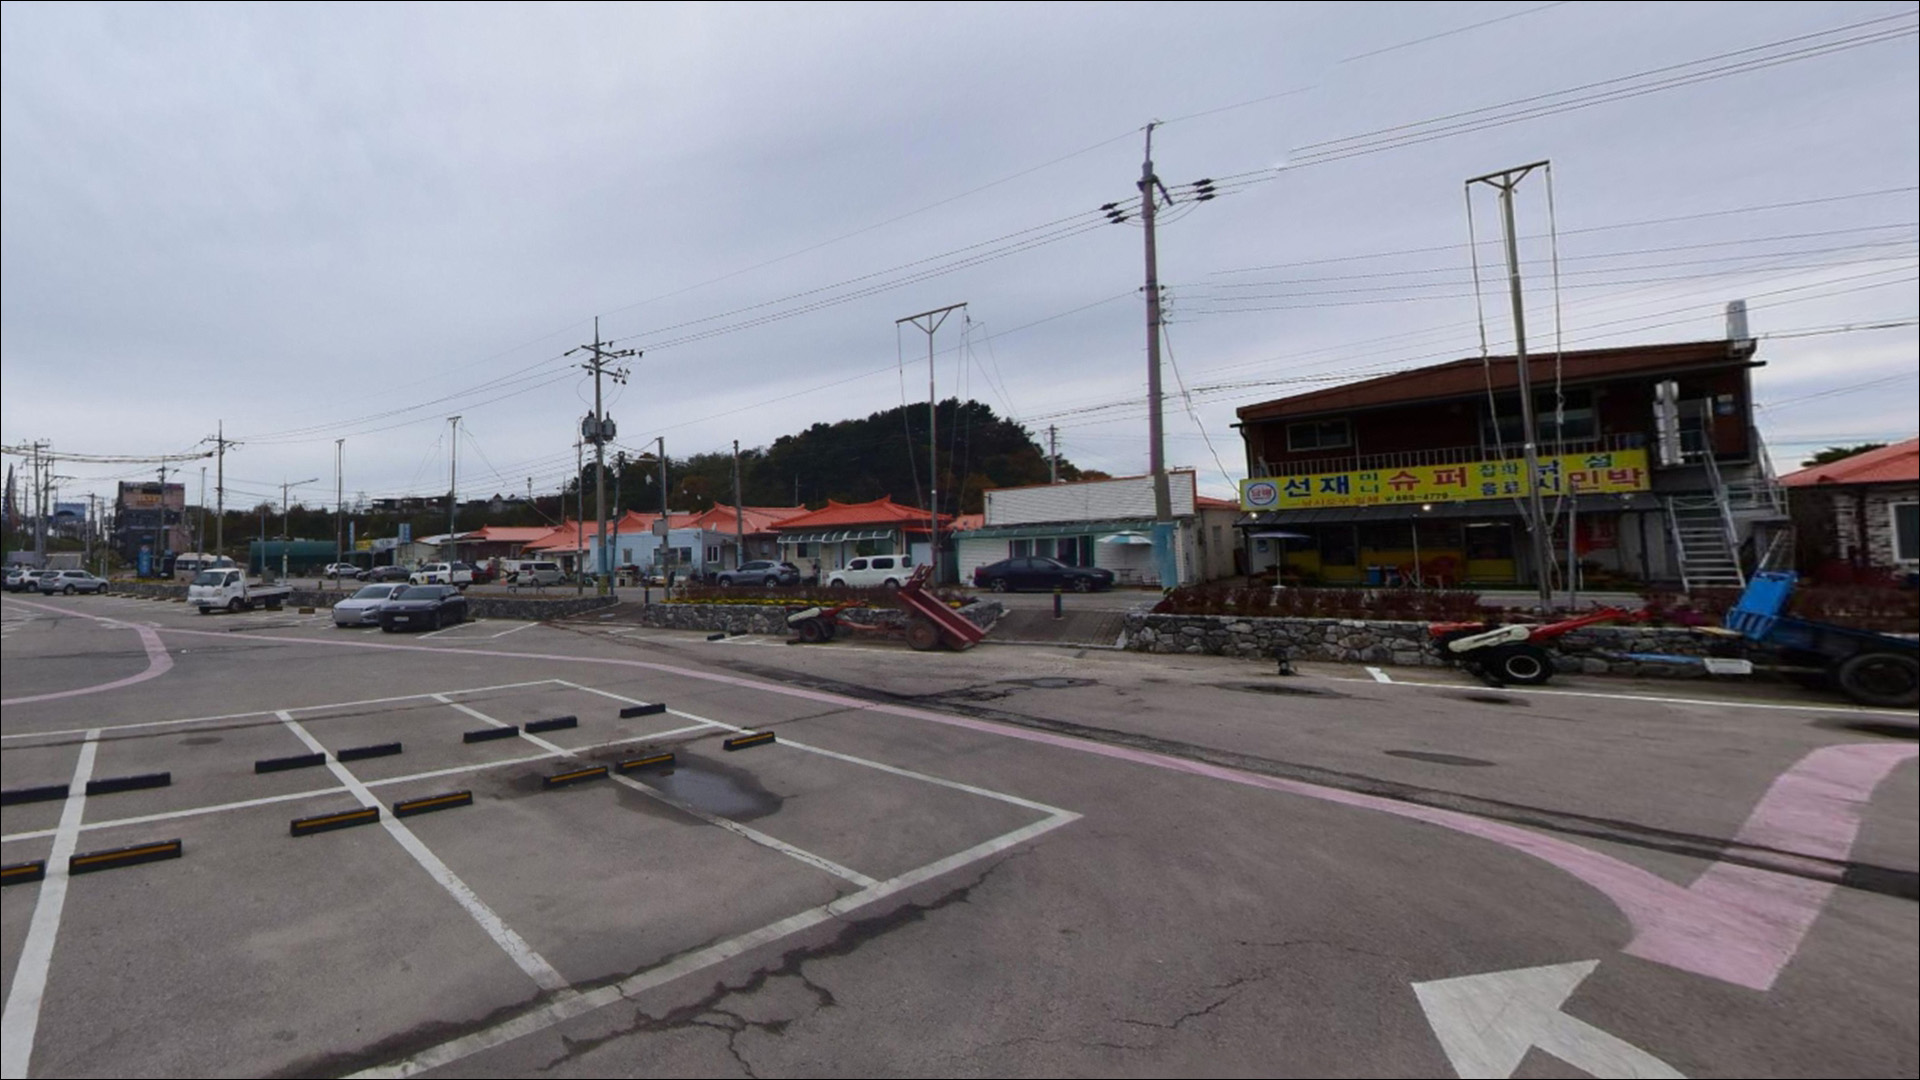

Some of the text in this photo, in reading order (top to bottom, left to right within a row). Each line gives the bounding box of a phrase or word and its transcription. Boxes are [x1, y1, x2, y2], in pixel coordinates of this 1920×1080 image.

[1284, 467, 1467, 498] 선재 미니 슈퍼
[1569, 467, 1645, 491] 민박
